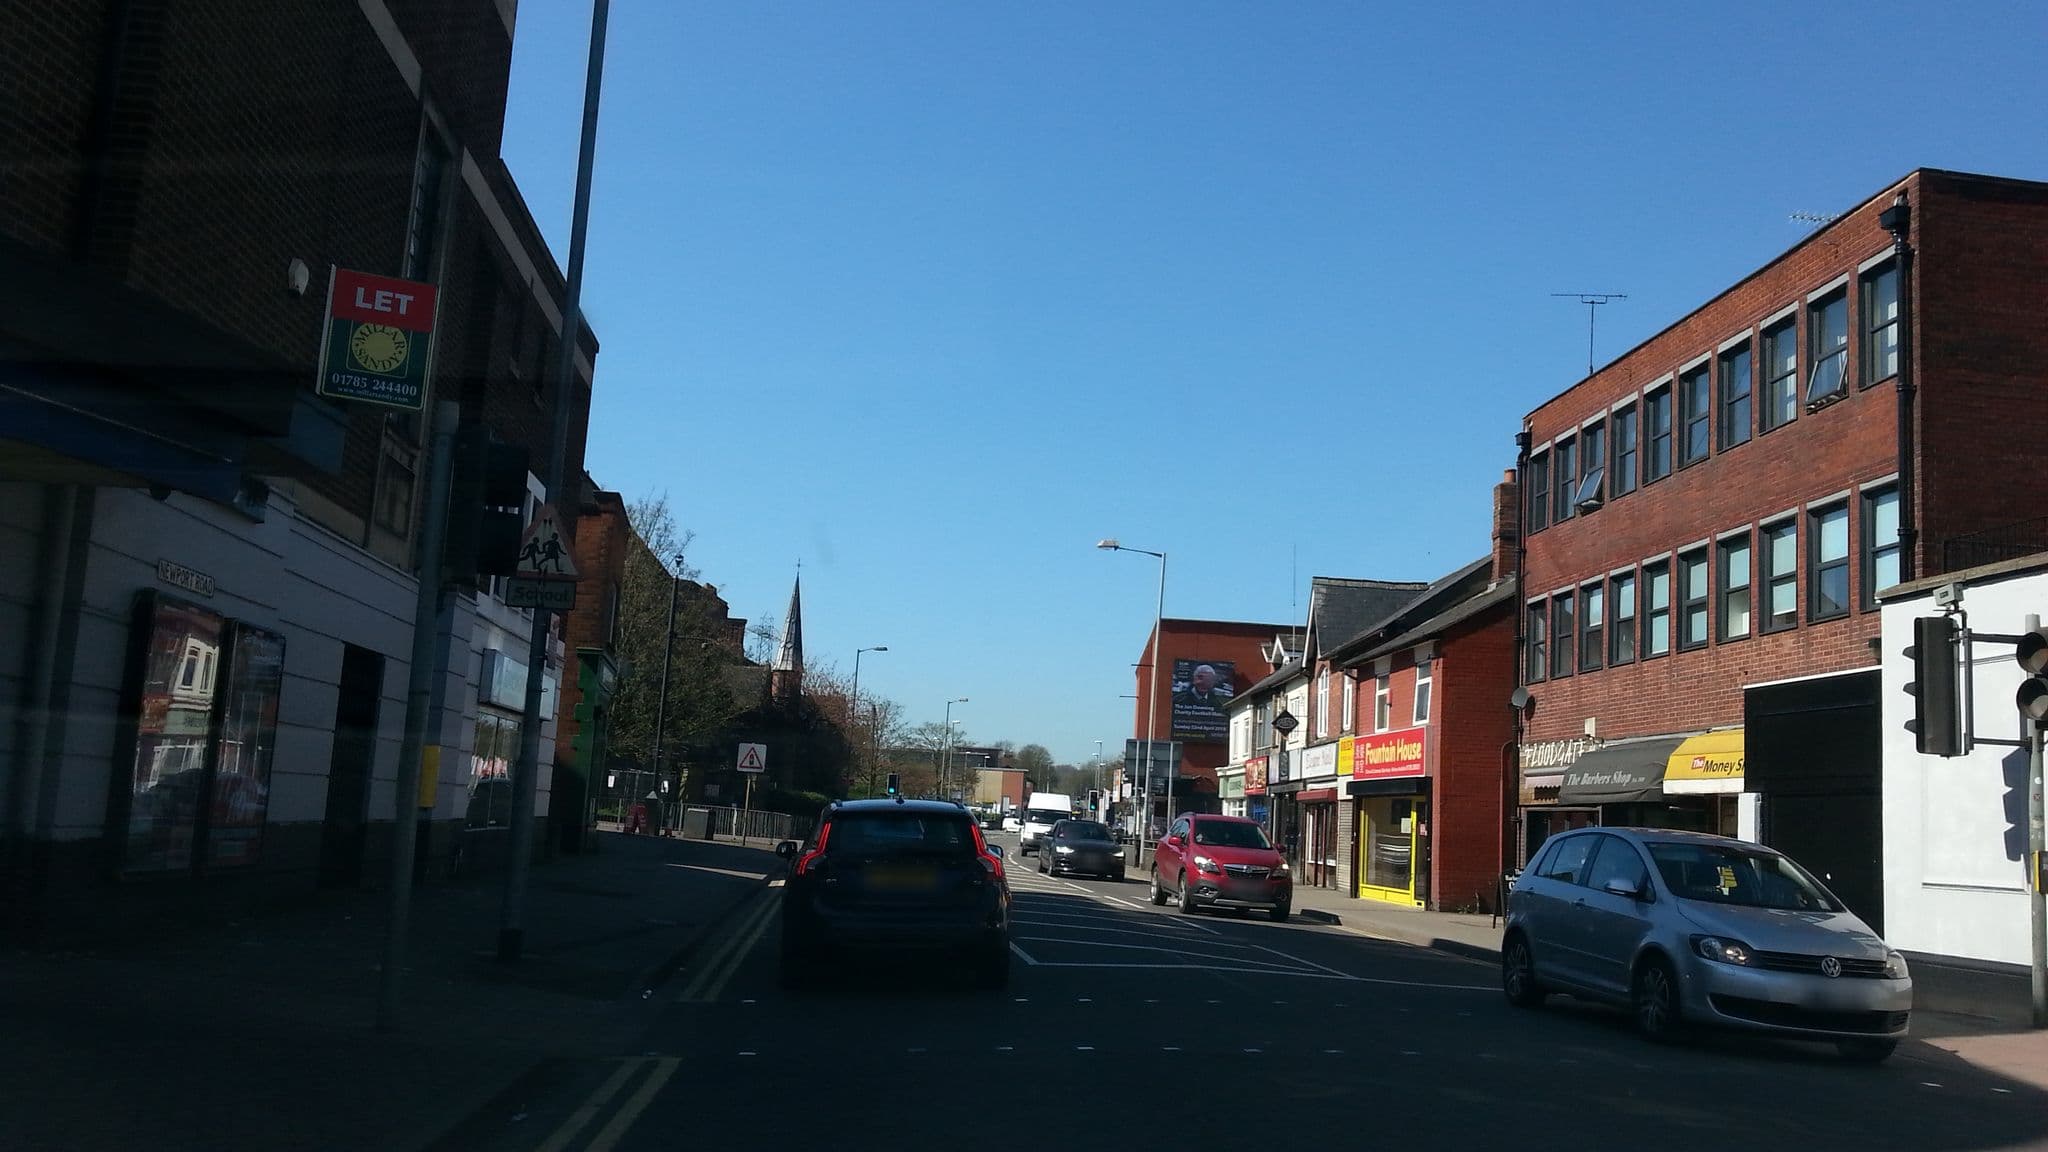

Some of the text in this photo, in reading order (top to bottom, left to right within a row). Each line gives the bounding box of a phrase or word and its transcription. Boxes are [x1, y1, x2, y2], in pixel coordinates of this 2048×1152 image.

[355, 287, 414, 315] LET
[354, 323, 406, 353] MILLAR
[358, 347, 401, 370] SANDY
[332, 373, 417, 396] 01785 244400
[160, 562, 214, 595] NEWPORT ROAD
[514, 585, 568, 601] School
[1365, 740, 1396, 765] Fountain
[1397, 738, 1422, 761] House
[1567, 774, 1580, 785] The
[1581, 772, 1611, 785] Barbers
[1611, 771, 1632, 787] Shop
[1693, 760, 1704, 768] The
[1703, 760, 1734, 775] Money
